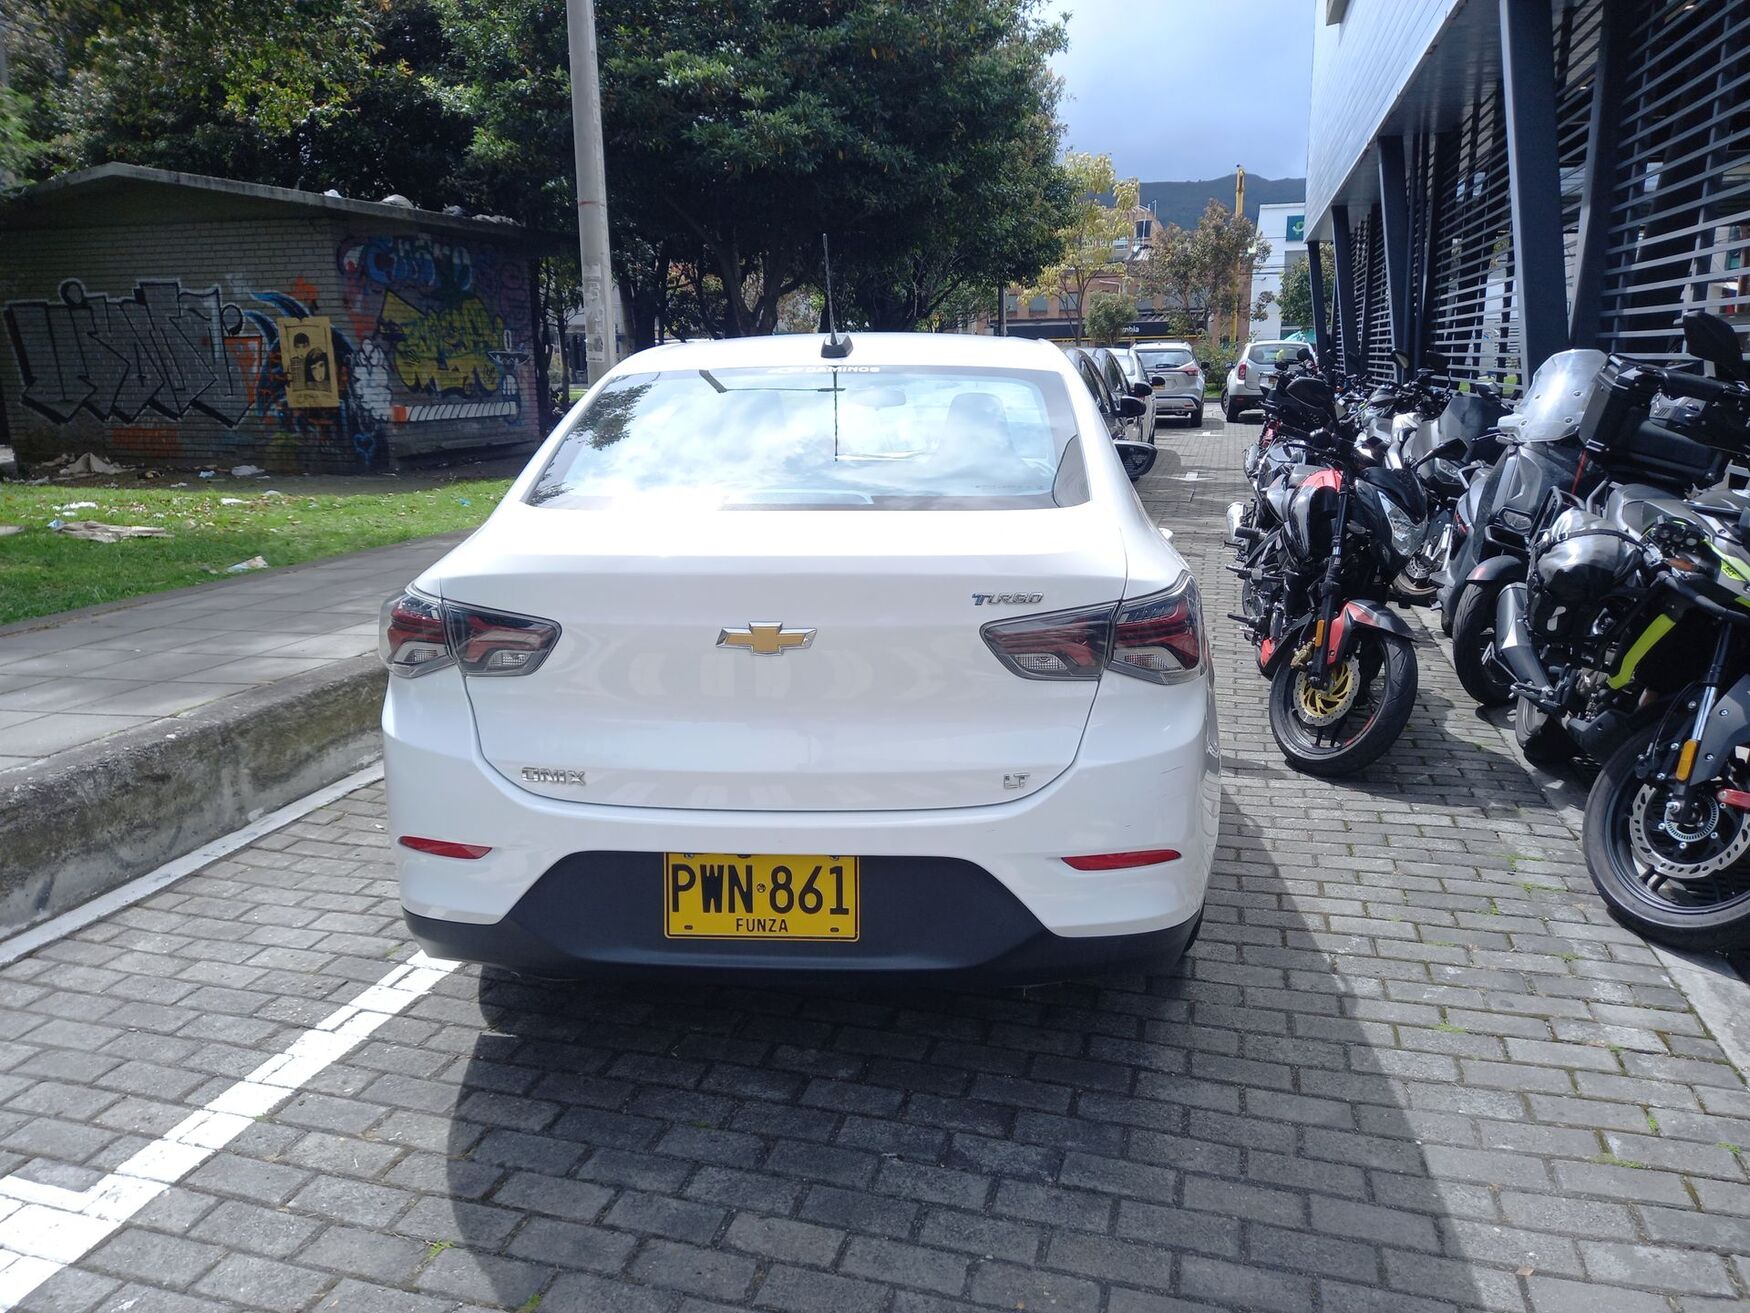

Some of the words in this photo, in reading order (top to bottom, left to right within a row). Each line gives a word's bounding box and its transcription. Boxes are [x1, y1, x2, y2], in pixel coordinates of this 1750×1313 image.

[971, 592, 1044, 606] TURBO
[521, 767, 586, 786] ONIX
[1003, 772, 1031, 789] LT
[671, 864, 754, 914] PWN
[769, 865, 850, 915] 861
[735, 917, 789, 933] FUNZA
